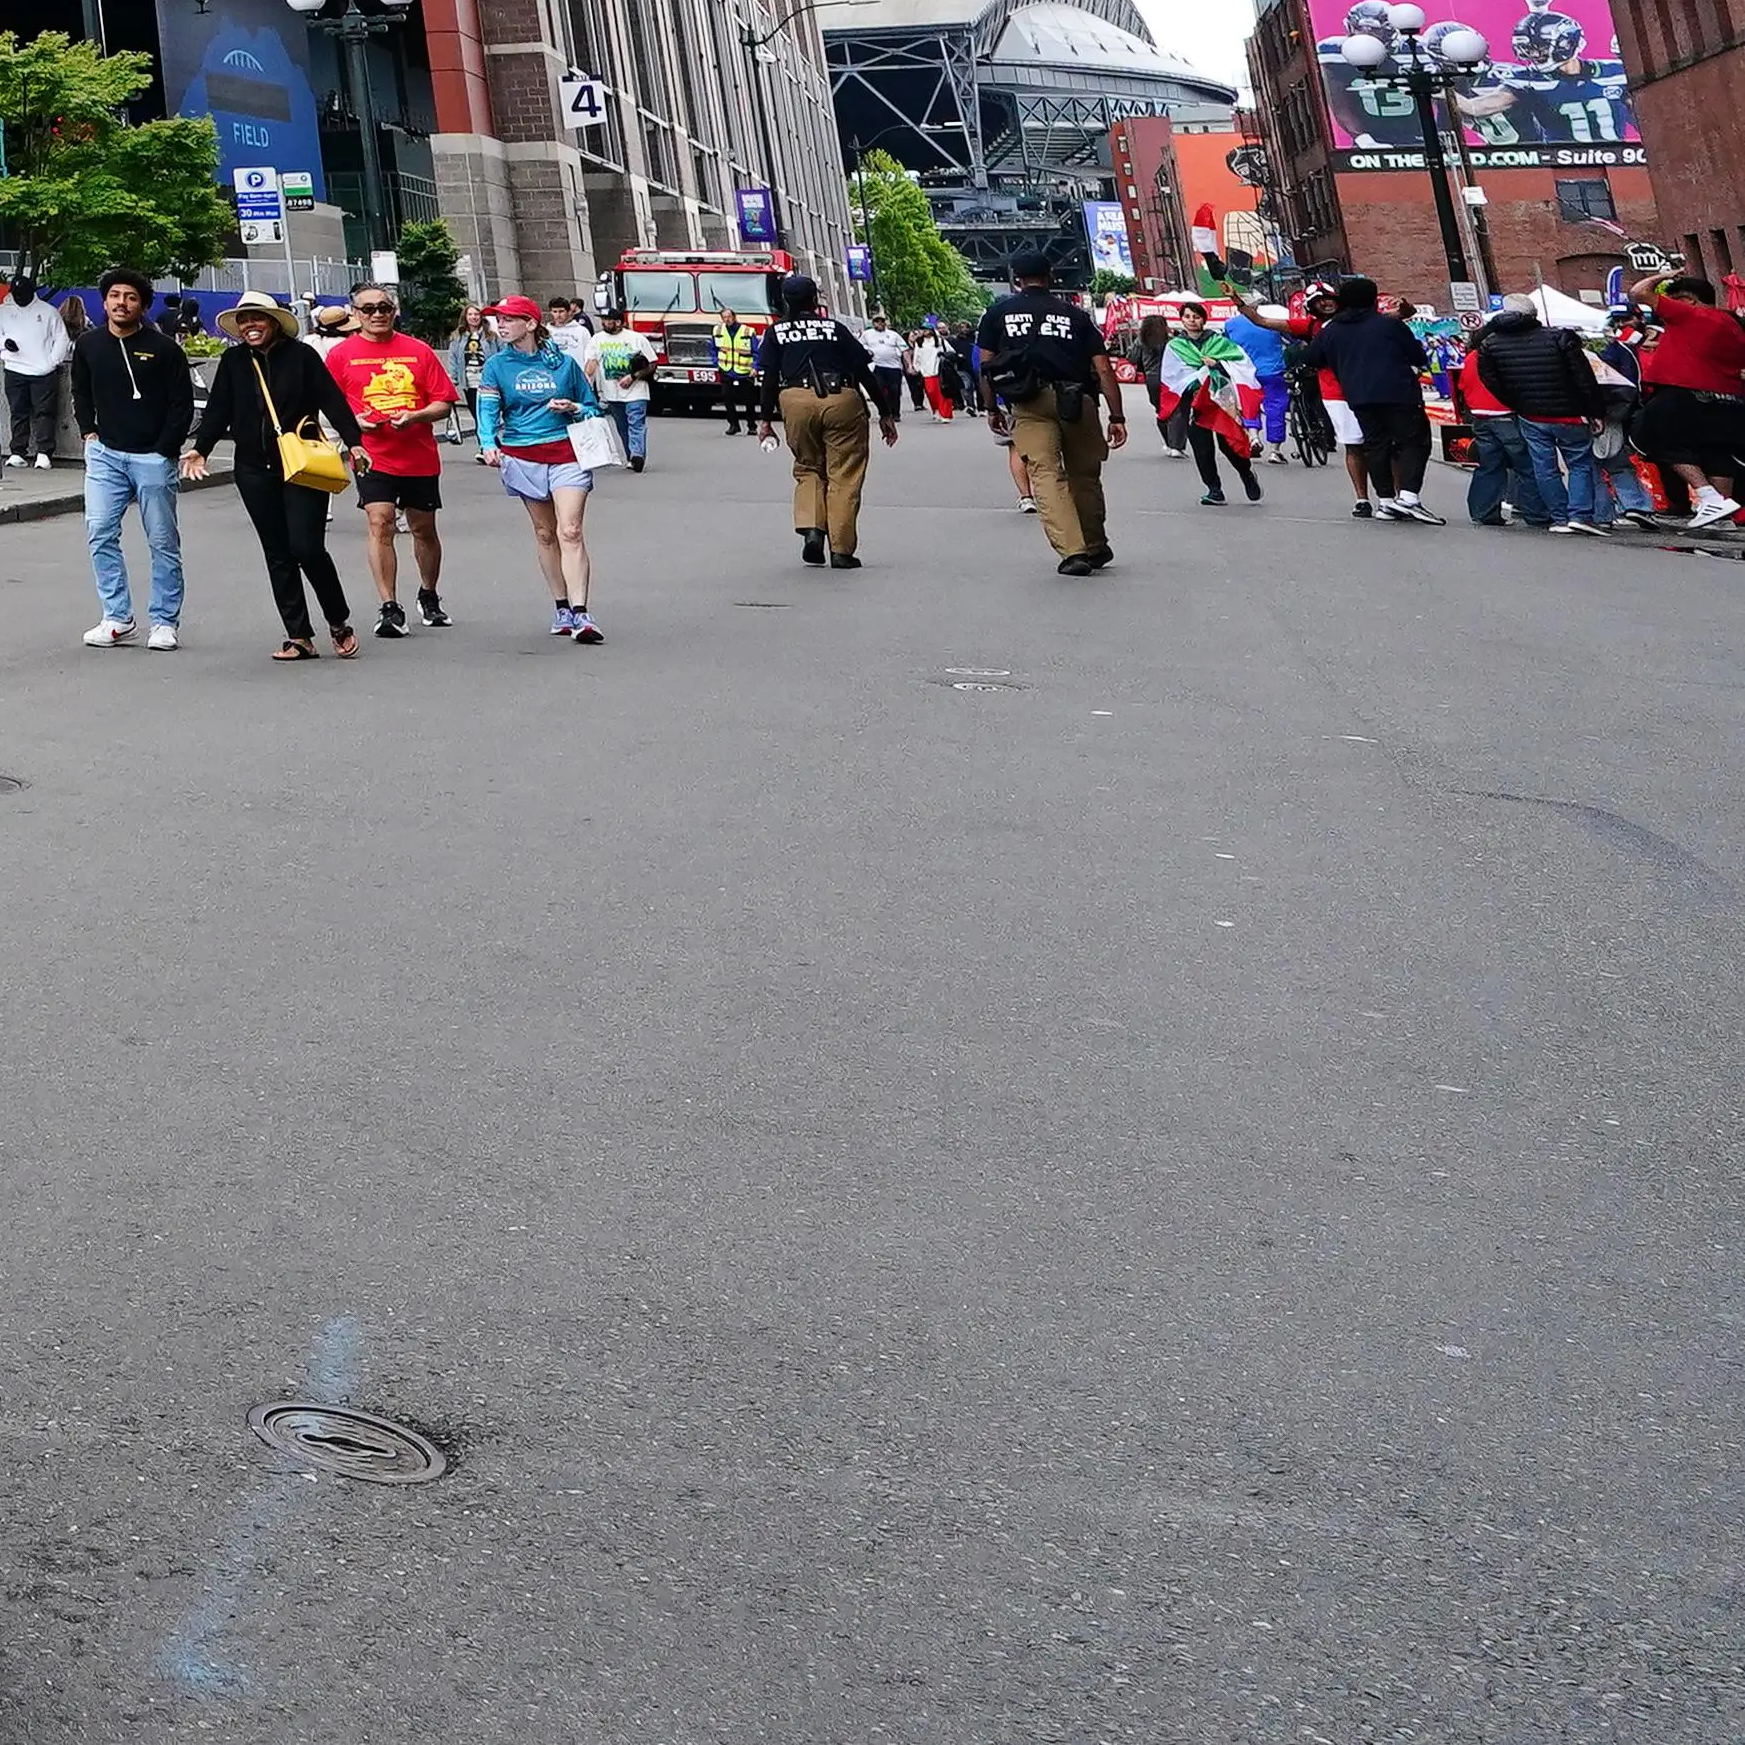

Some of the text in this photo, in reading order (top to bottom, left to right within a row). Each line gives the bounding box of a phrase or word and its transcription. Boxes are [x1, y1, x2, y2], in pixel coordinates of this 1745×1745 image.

[571, 85, 602, 118] 4
[1559, 98, 1620, 143] 11
[232, 122, 269, 148] FIELD
[1350, 154, 1381, 168] ON
[1381, 153, 1425, 168] THE
[1557, 149, 1617, 164] Suite
[240, 209, 252, 217] 30
[807, 320, 836, 329] POLICE
[1046, 315, 1071, 325] OLICE
[776, 328, 838, 345] P.O.E.T.
[693, 371, 716, 382] E95
